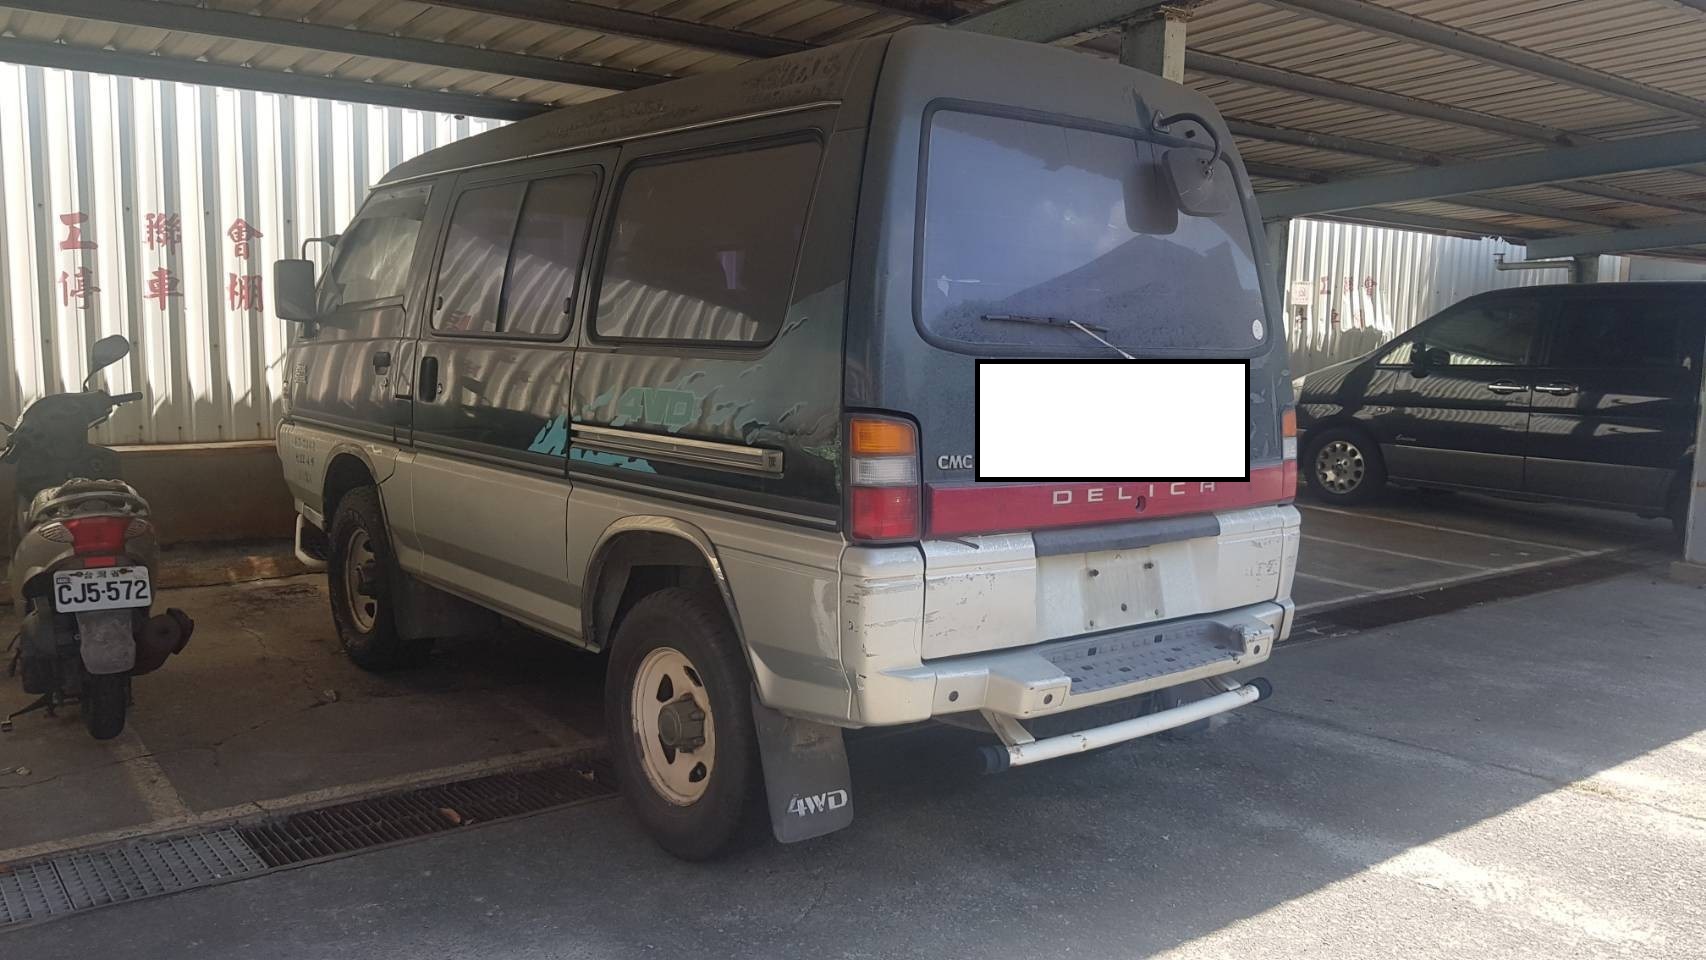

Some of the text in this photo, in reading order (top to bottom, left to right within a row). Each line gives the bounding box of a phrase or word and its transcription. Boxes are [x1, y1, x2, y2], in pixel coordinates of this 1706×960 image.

[617, 386, 697, 426] 4WD
[937, 455, 973, 470] CMC
[1052, 481, 1216, 505] DELICA
[787, 788, 848, 817] 4WD
